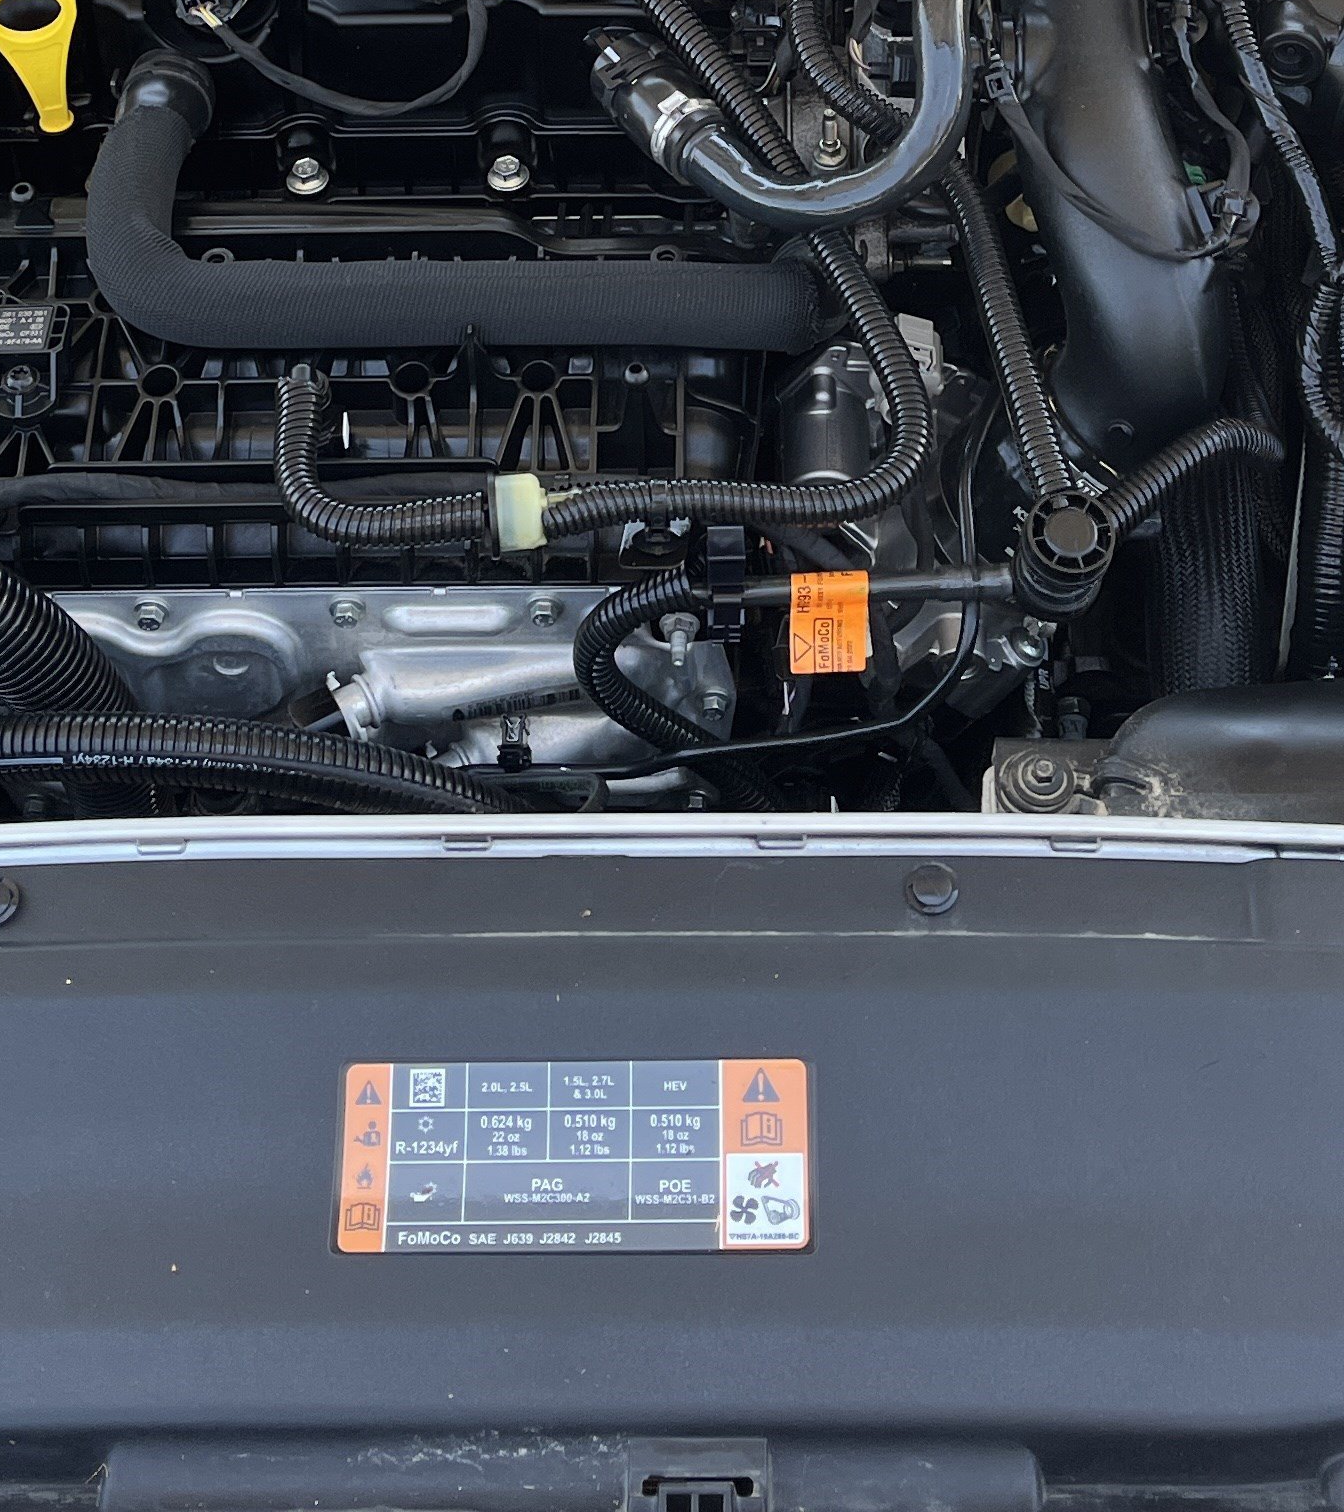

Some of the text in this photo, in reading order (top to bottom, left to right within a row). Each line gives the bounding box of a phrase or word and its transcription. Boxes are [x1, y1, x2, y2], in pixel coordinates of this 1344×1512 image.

[817, 621, 831, 669] FoMoCo
[563, 1076, 614, 1087] 1.5L, 2.7L
[664, 1081, 687, 1091] HEV
[481, 1082, 533, 1093] 2.0L, 2.5L
[573, 1089, 607, 1099] & 3.0L
[480, 1115, 532, 1131] 0.624 kg
[564, 1114, 616, 1130] 0.510 kg
[650, 1114, 701, 1129] 0.510 kg
[492, 1132, 520, 1142] 22 oz
[577, 1130, 604, 1141] 18 oz
[662, 1130, 689, 1140] 18 oz
[395, 1141, 458, 1156] R-1234yf
[487, 1145, 527, 1156] 1.38 lbs
[570, 1144, 610, 1155] 1.12 lbs
[656, 1143, 695, 1154] 1.12 lbs
[531, 1179, 563, 1192] PAG
[659, 1179, 692, 1193] POE
[398, 1231, 622, 1245] FoMoCo SAE J639 J2842 J2845
